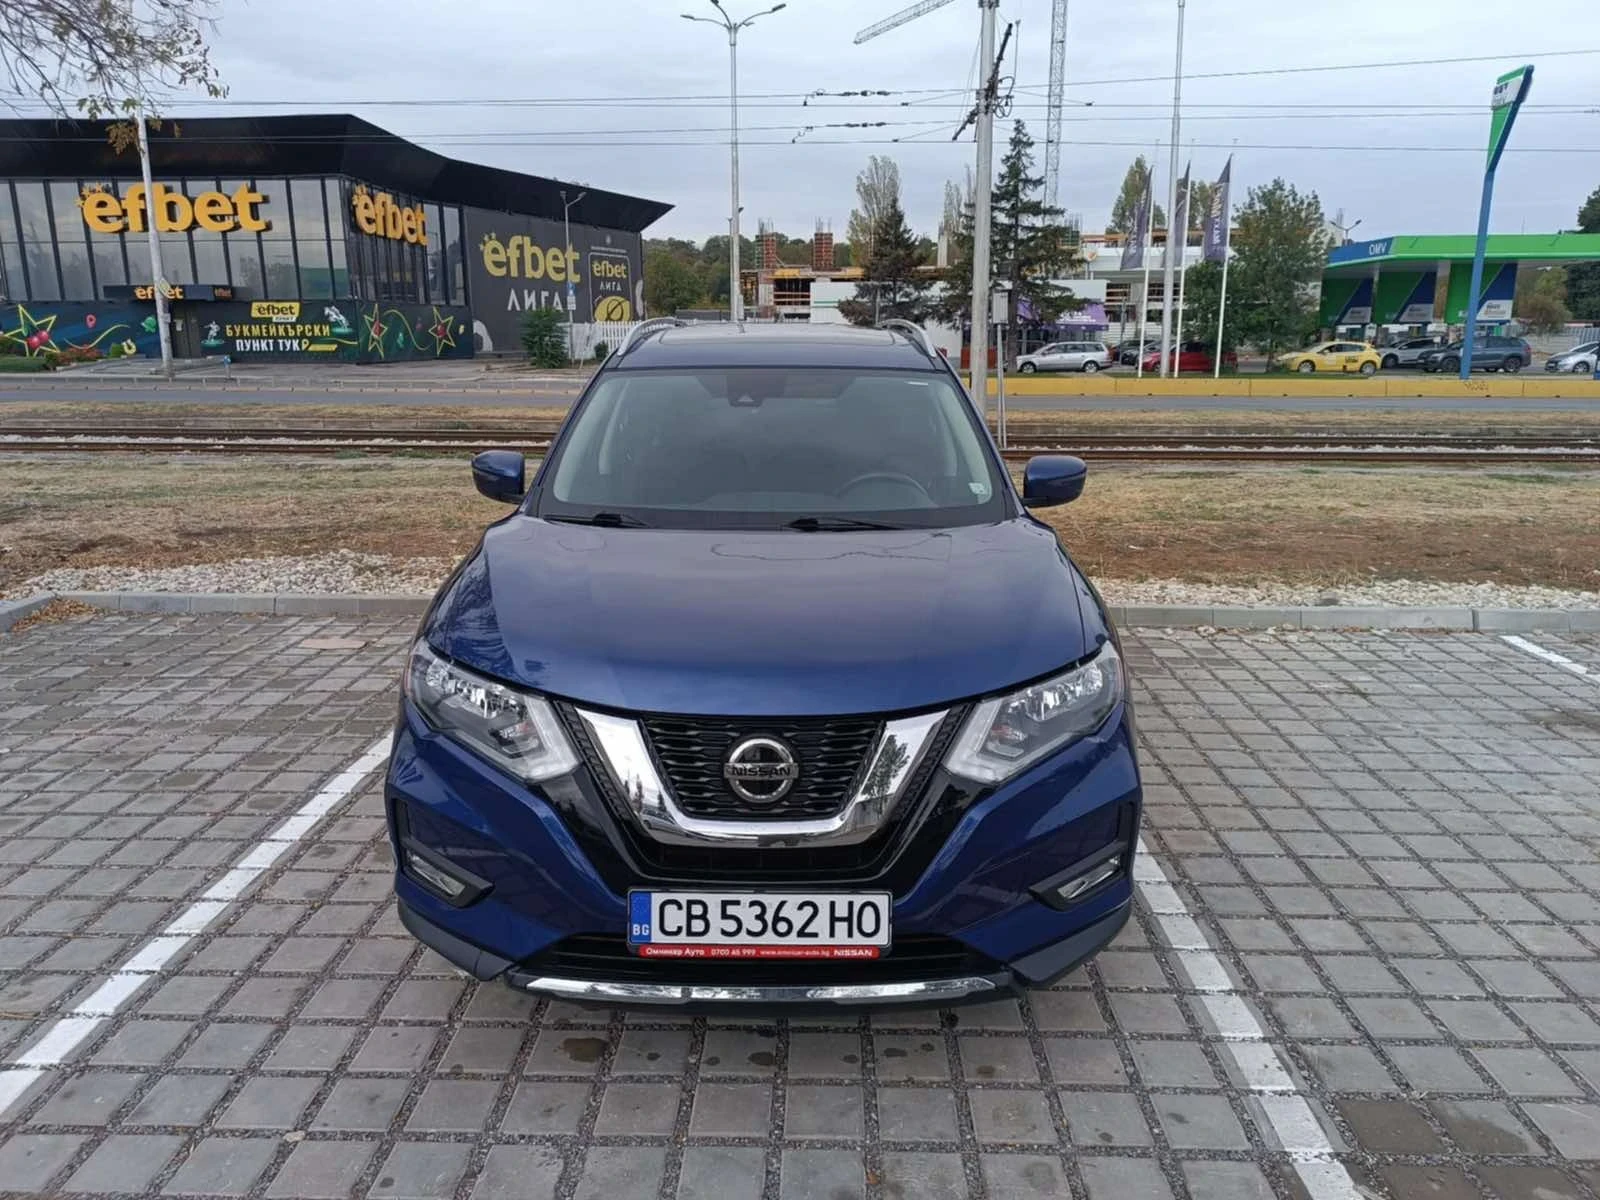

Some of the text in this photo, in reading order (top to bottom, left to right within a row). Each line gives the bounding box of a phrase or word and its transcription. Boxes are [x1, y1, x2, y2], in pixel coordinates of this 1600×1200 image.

[80, 182, 269, 233] efbet
[354, 187, 428, 246] efbet
[1368, 241, 1387, 256] OMV
[481, 234, 581, 283] efbet
[592, 260, 627, 278] efbet
[135, 286, 184, 299] efet
[600, 281, 622, 292] ЛИГА
[507, 288, 564, 313] ЛИГА
[256, 304, 296, 316] efbet
[225, 323, 331, 337] БУКМЕЙКЪРСКИ
[236, 339, 301, 352] ПУНКТ ТУК
[732, 766, 791, 777] NISSAN
[632, 924, 650, 936] BG
